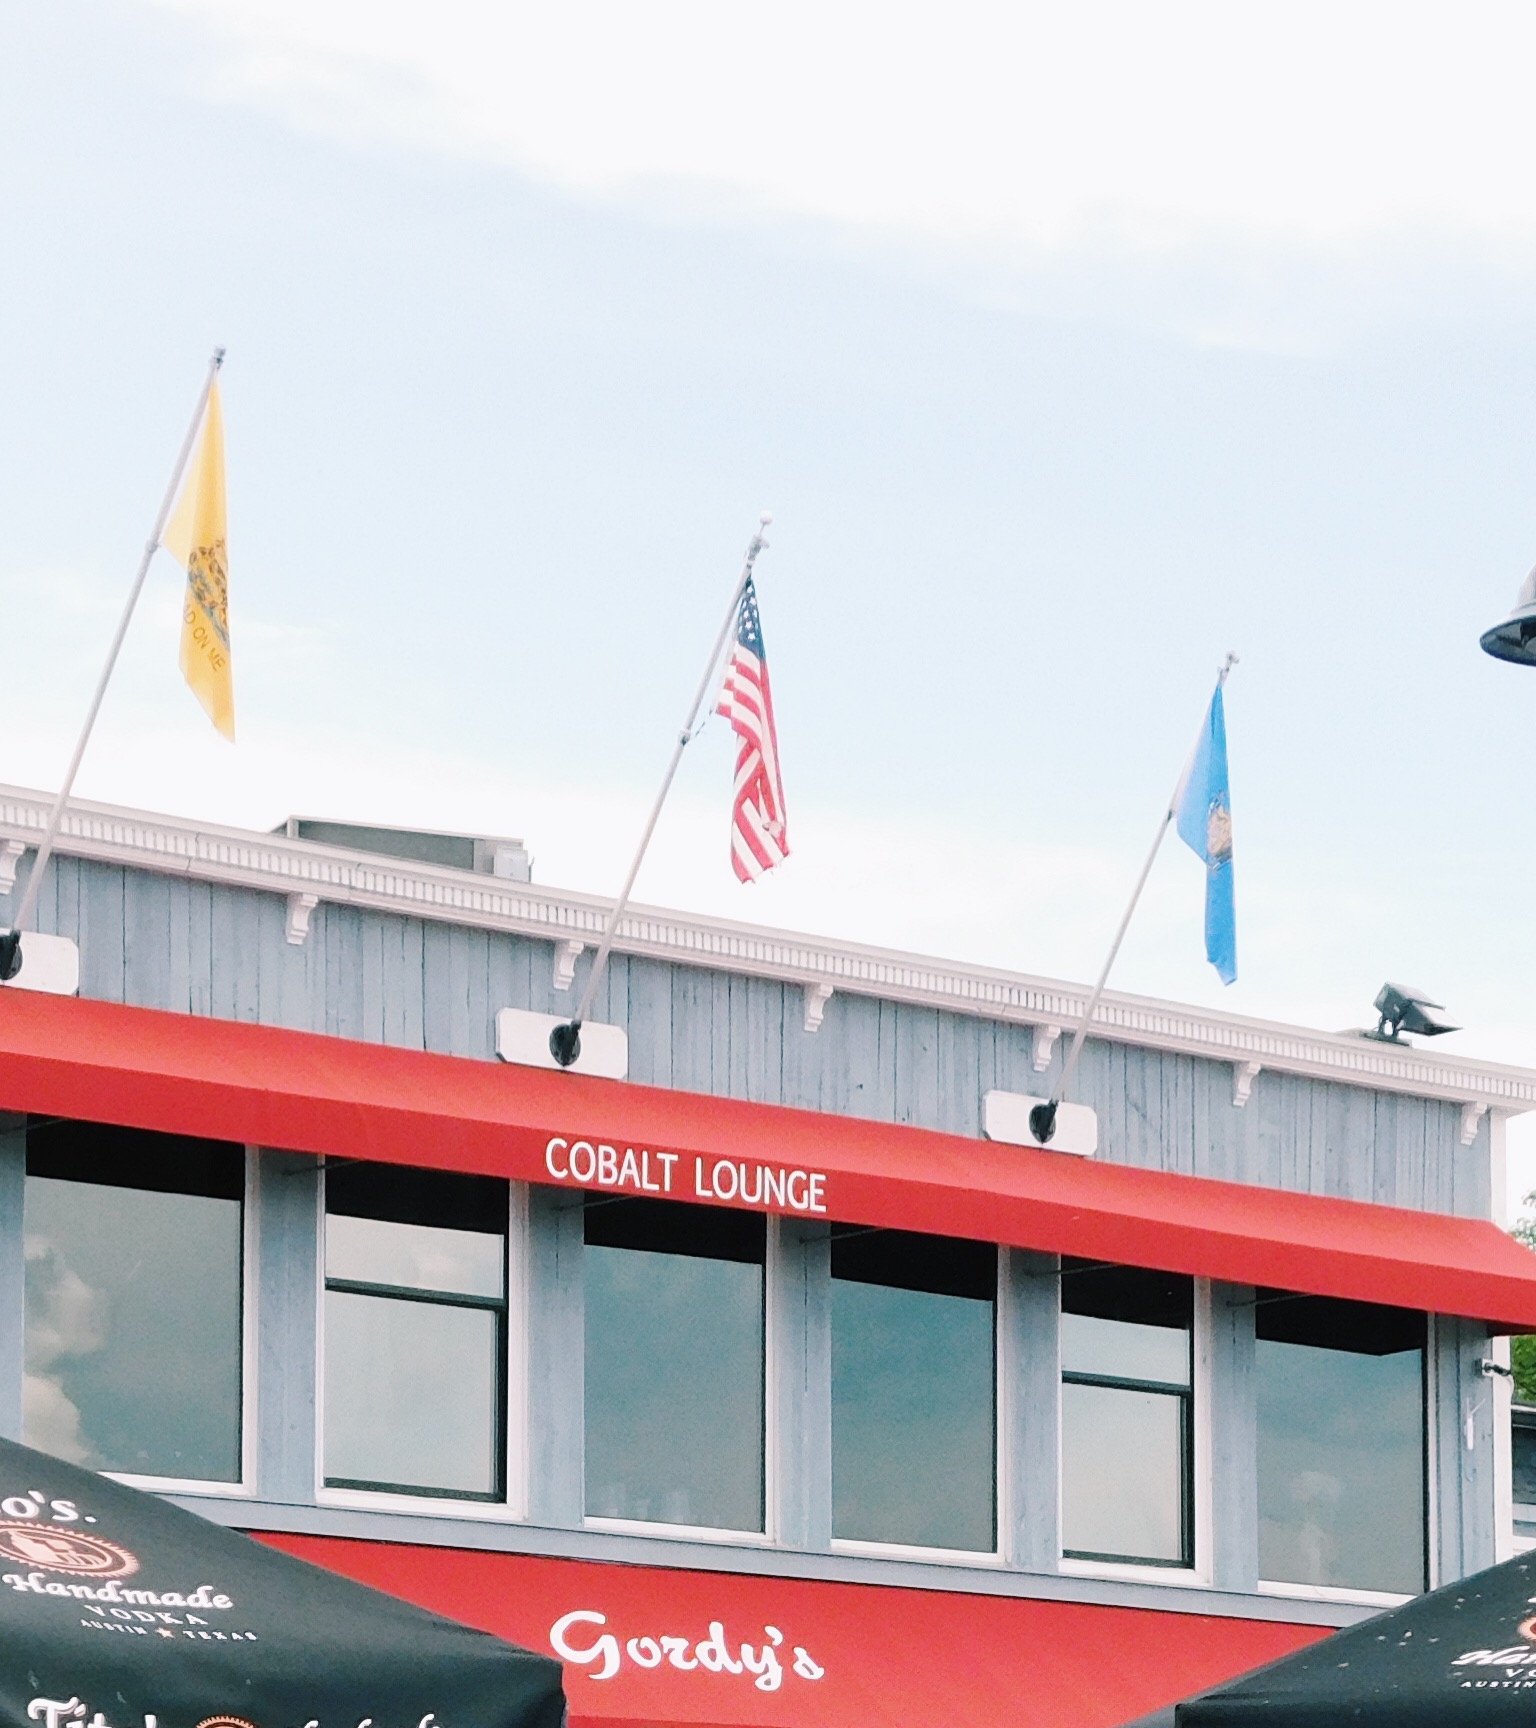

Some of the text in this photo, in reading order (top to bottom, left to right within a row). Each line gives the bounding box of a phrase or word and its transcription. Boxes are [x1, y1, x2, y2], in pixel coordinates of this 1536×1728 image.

[545, 1137, 828, 1212] COBALT LOUNGE
[1, 1572, 234, 1609] Handmade
[80, 1618, 258, 1641] AUSTIN TEXAS
[84, 1604, 209, 1626] VODKA
[549, 1609, 825, 1692] Gordy's
[1460, 1680, 1536, 1688] AUSTIN
